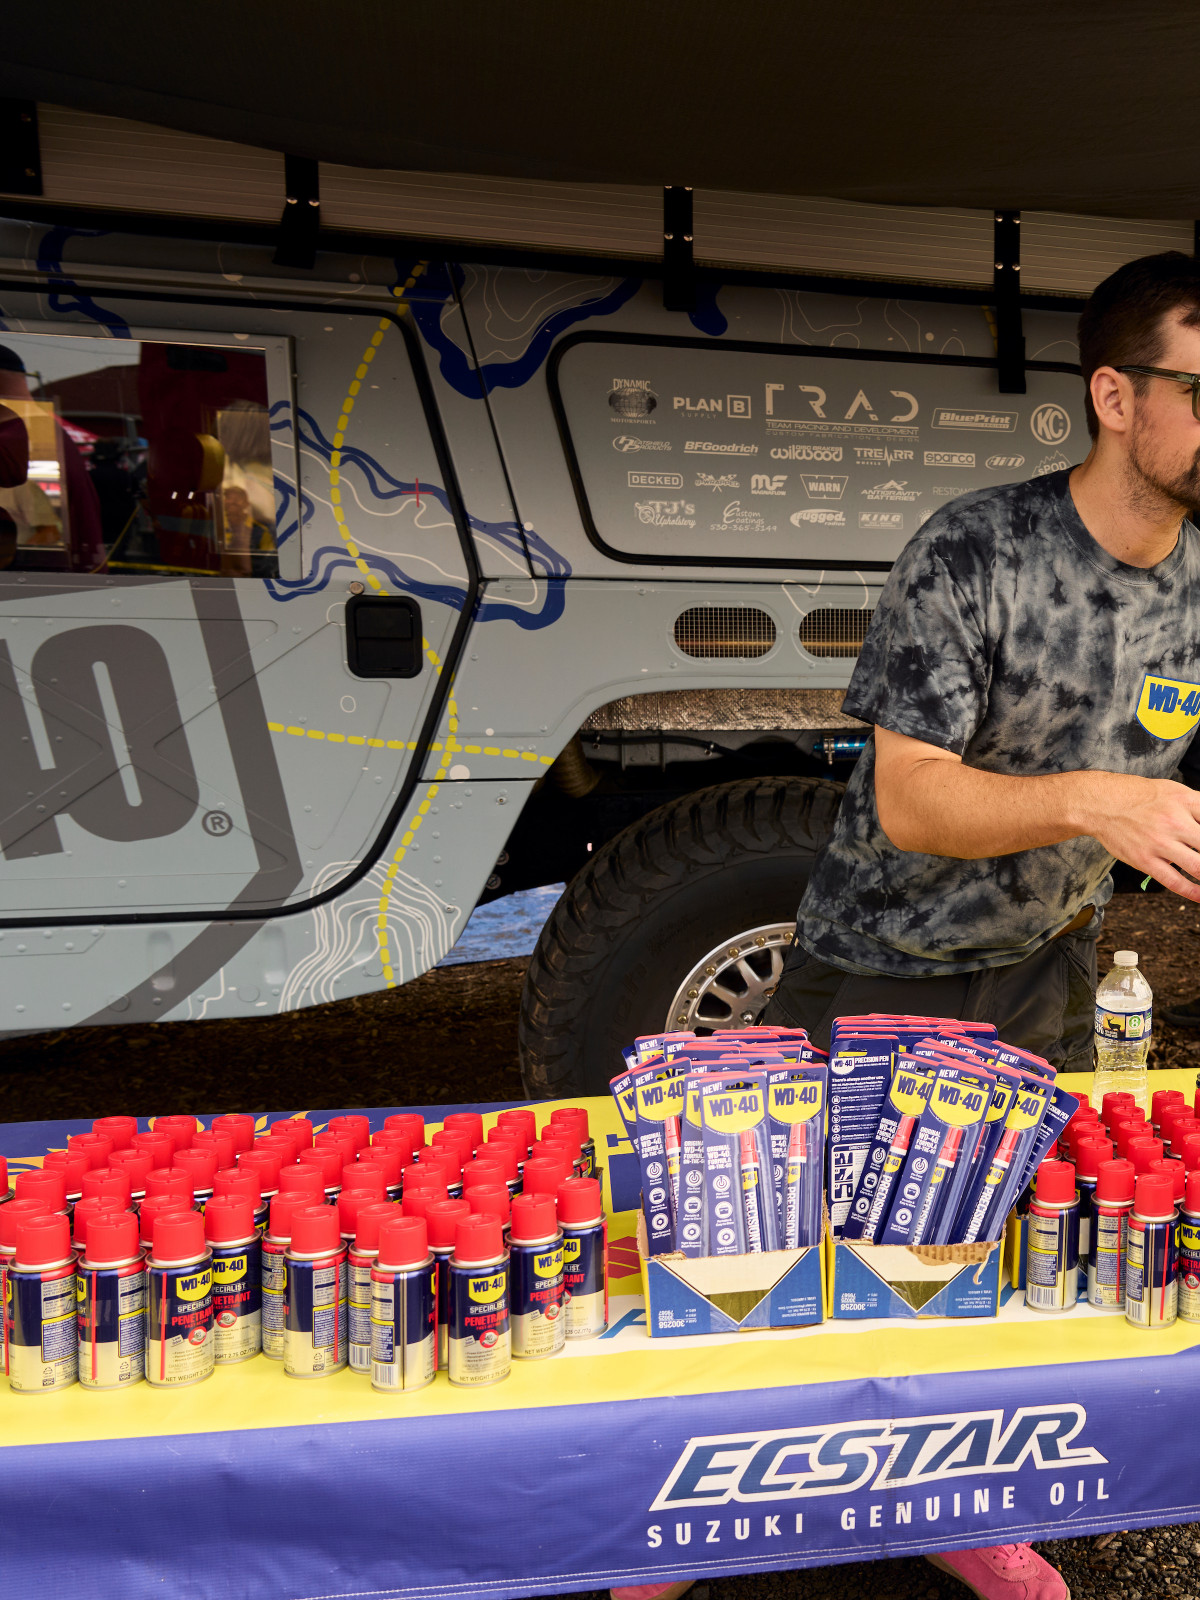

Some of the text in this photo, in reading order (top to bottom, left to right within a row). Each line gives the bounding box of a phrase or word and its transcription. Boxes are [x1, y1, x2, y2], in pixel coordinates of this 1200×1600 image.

[612, 378, 651, 391] DYNAMIC
[673, 397, 745, 414] PLAN B
[765, 383, 919, 423] TRAD
[610, 417, 657, 425] MOTORSPORTS
[940, 412, 1011, 424] BluePrint
[1037, 408, 1063, 440] KC
[794, 423, 833, 431] RACING
[854, 426, 919, 435] DEVELOPMENT
[684, 441, 759, 453] BFGoodrich
[926, 452, 974, 464] sparco
[1038, 461, 1066, 475] sPOD
[632, 475, 679, 486] DECKED
[809, 482, 841, 492] WARN
[648, 500, 696, 515] TJ's
[655, 514, 696, 528] Upholstery
[861, 513, 901, 522] KING
[639, 1039, 658, 1051] NEW!
[898, 1061, 916, 1069] NEW!
[999, 1053, 1019, 1064] NEW!
[635, 1072, 654, 1087] NEW!
[769, 1071, 788, 1083] NEW!
[939, 1069, 958, 1078] NEW!
[613, 1076, 632, 1094] NEW!
[703, 1082, 723, 1095] NEW!
[897, 1074, 932, 1100] WD-40
[642, 1080, 684, 1107] WD-40
[773, 1086, 818, 1106] WD-40
[938, 1083, 983, 1112] WD-40
[709, 1095, 759, 1117] WD-40
[868, 1174, 892, 1223] PRECISION
[917, 1186, 936, 1235] PRECISION
[970, 1185, 994, 1234] PRECISION
[745, 1191, 760, 1244] PRECISION
[786, 1187, 796, 1249] PRECISION PE
[538, 1251, 563, 1269] WD-40
[180, 1272, 211, 1292] WD-40
[473, 1276, 504, 1293] WD-40
[469, 1300, 505, 1314] SPECIALIST
[843, 1303, 866, 1311] 300258
[464, 1308, 508, 1326] PENETRANT
[658, 1320, 686, 1329] 300258
[536, 1345, 554, 1354] WEIGHT
[178, 1372, 199, 1381] WEIGHT
[470, 1373, 490, 1382] WEIGHT
[649, 1403, 1109, 1512] ECSTAR
[646, 1478, 1110, 1549] SUZUKI GENUINE OIL
